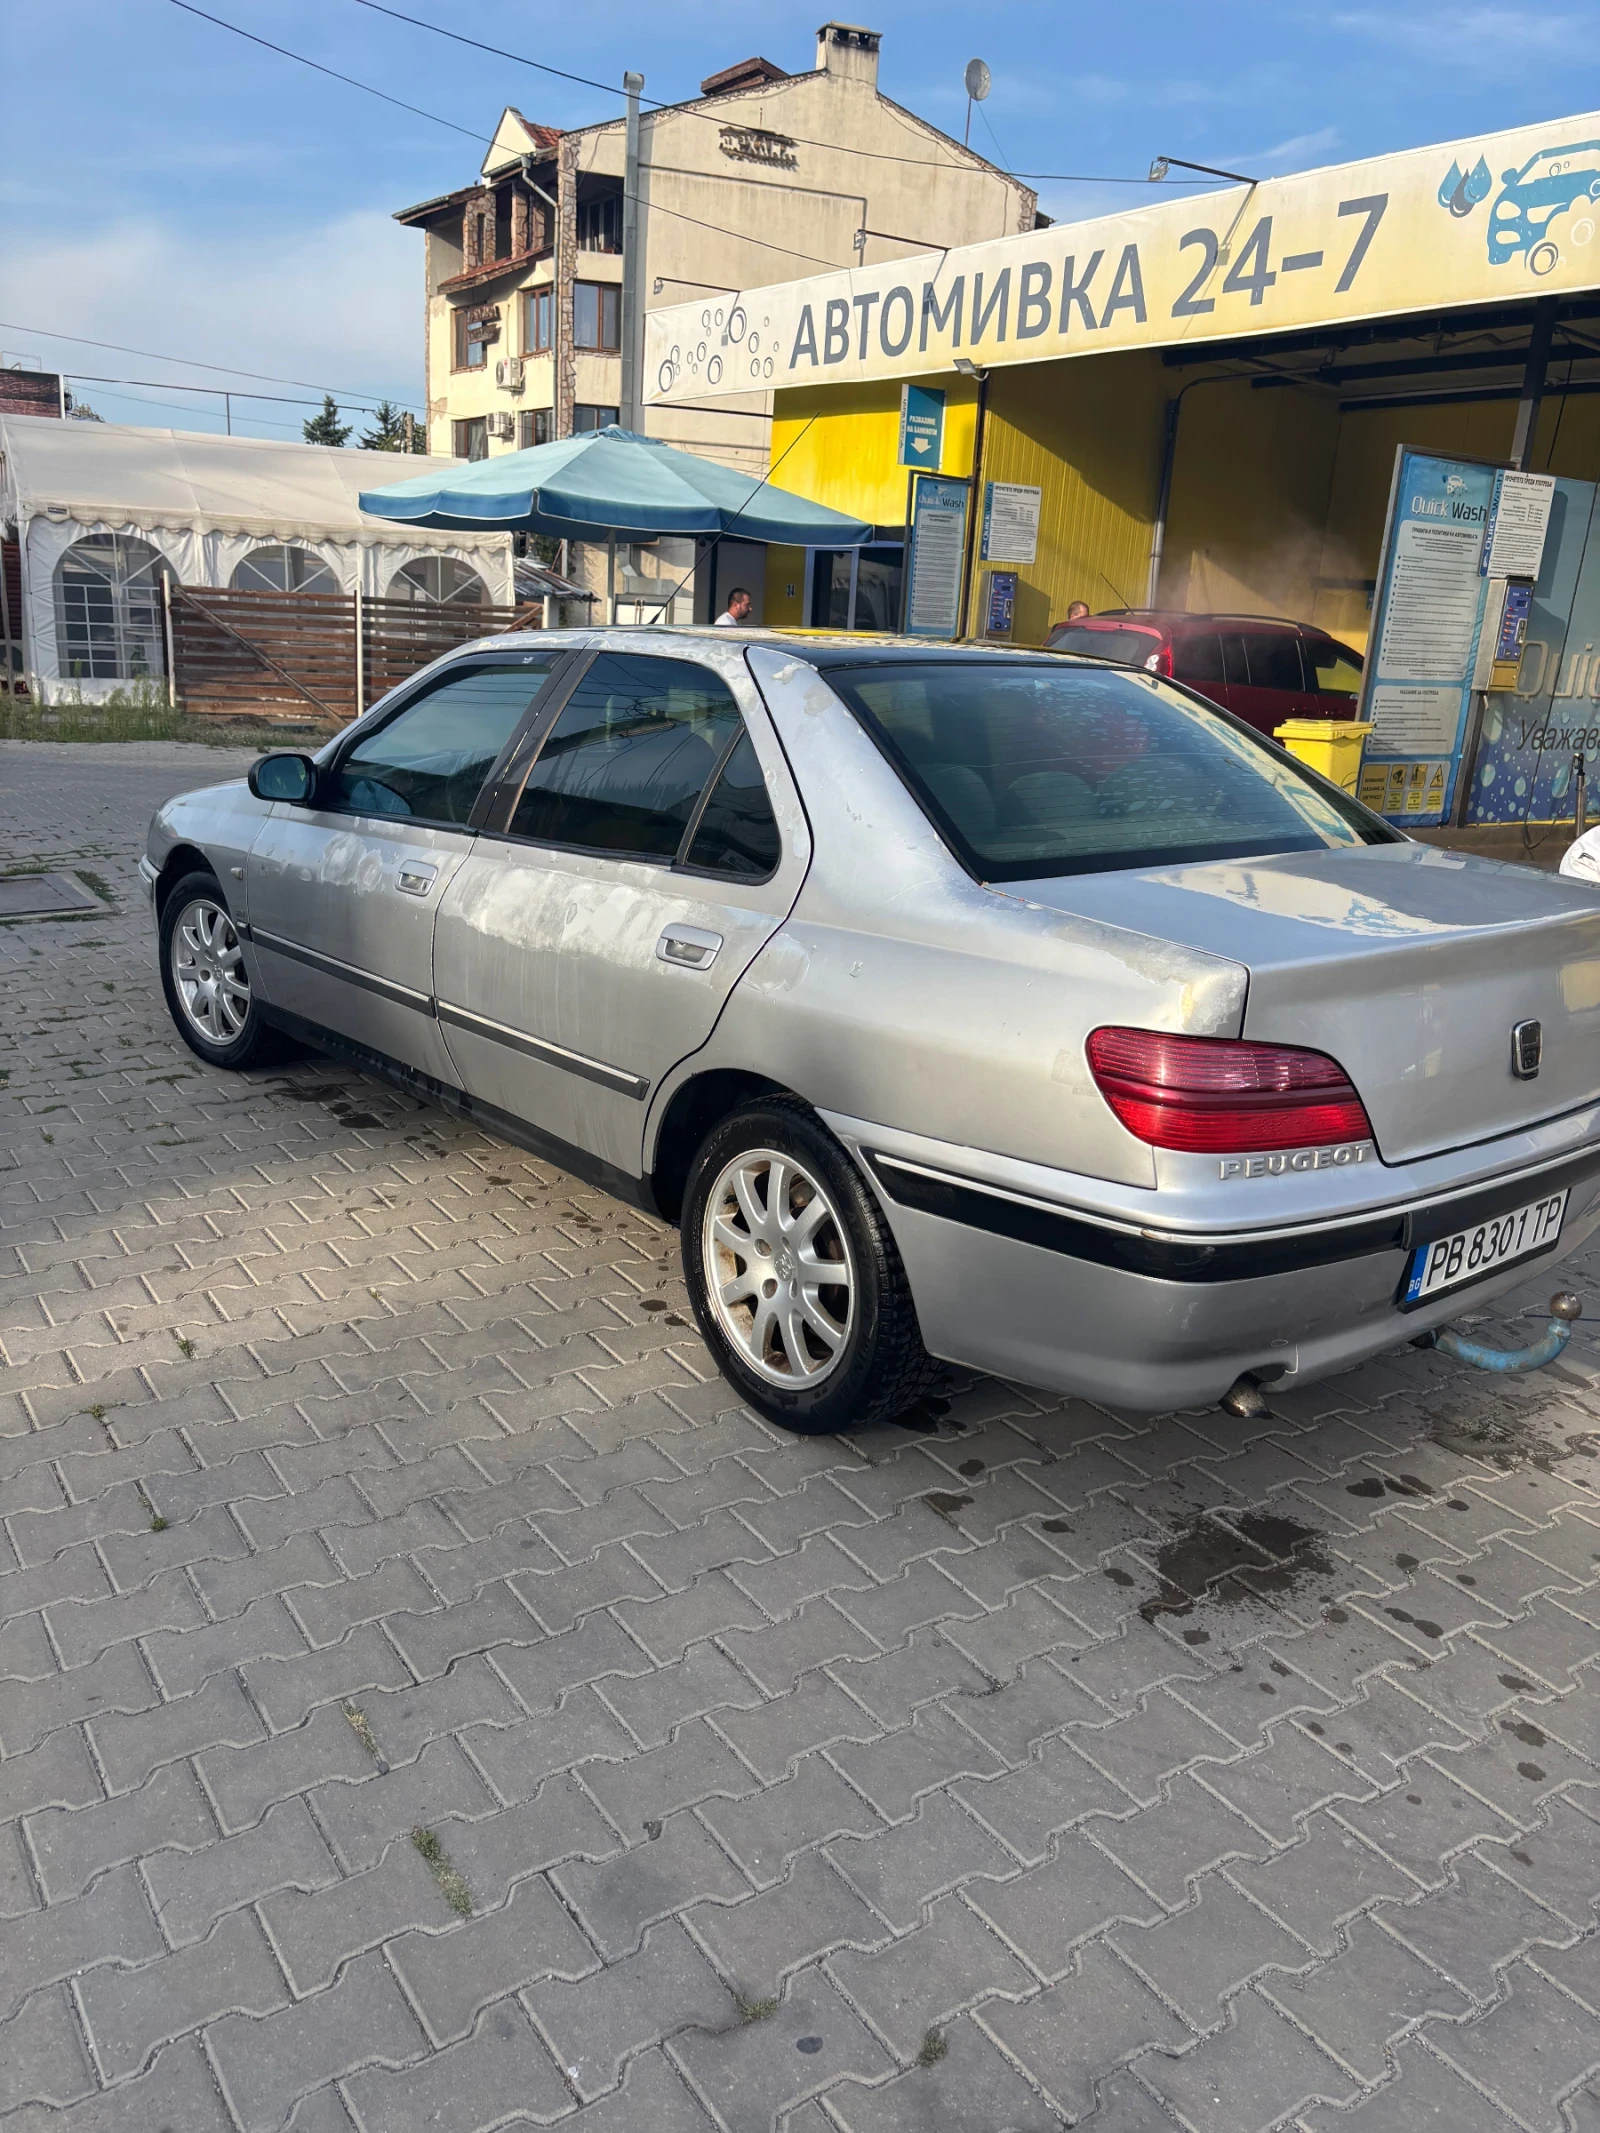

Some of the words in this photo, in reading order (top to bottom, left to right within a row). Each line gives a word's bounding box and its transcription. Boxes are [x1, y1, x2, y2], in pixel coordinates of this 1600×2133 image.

[789, 244, 1147, 369] АВТОМИВКА
[907, 425, 914, 433] НА
[918, 493, 940, 505] Quick
[942, 497, 964, 508] Wash
[985, 484, 994, 511] Wash
[1411, 496, 1449, 518] Quick
[1452, 501, 1488, 522] Wash
[1485, 514, 1497, 550] Quick
[1492, 473, 1503, 512] Wash
[983, 514, 991, 541] Quick
[1517, 719, 1600, 751] Уважав
[1218, 1143, 1371, 1181] PEUGEOT
[1426, 1234, 1466, 1288] PB
[1467, 1208, 1529, 1270] 8301
[1532, 1195, 1562, 1243] TP
[1408, 1277, 1422, 1293] BG
